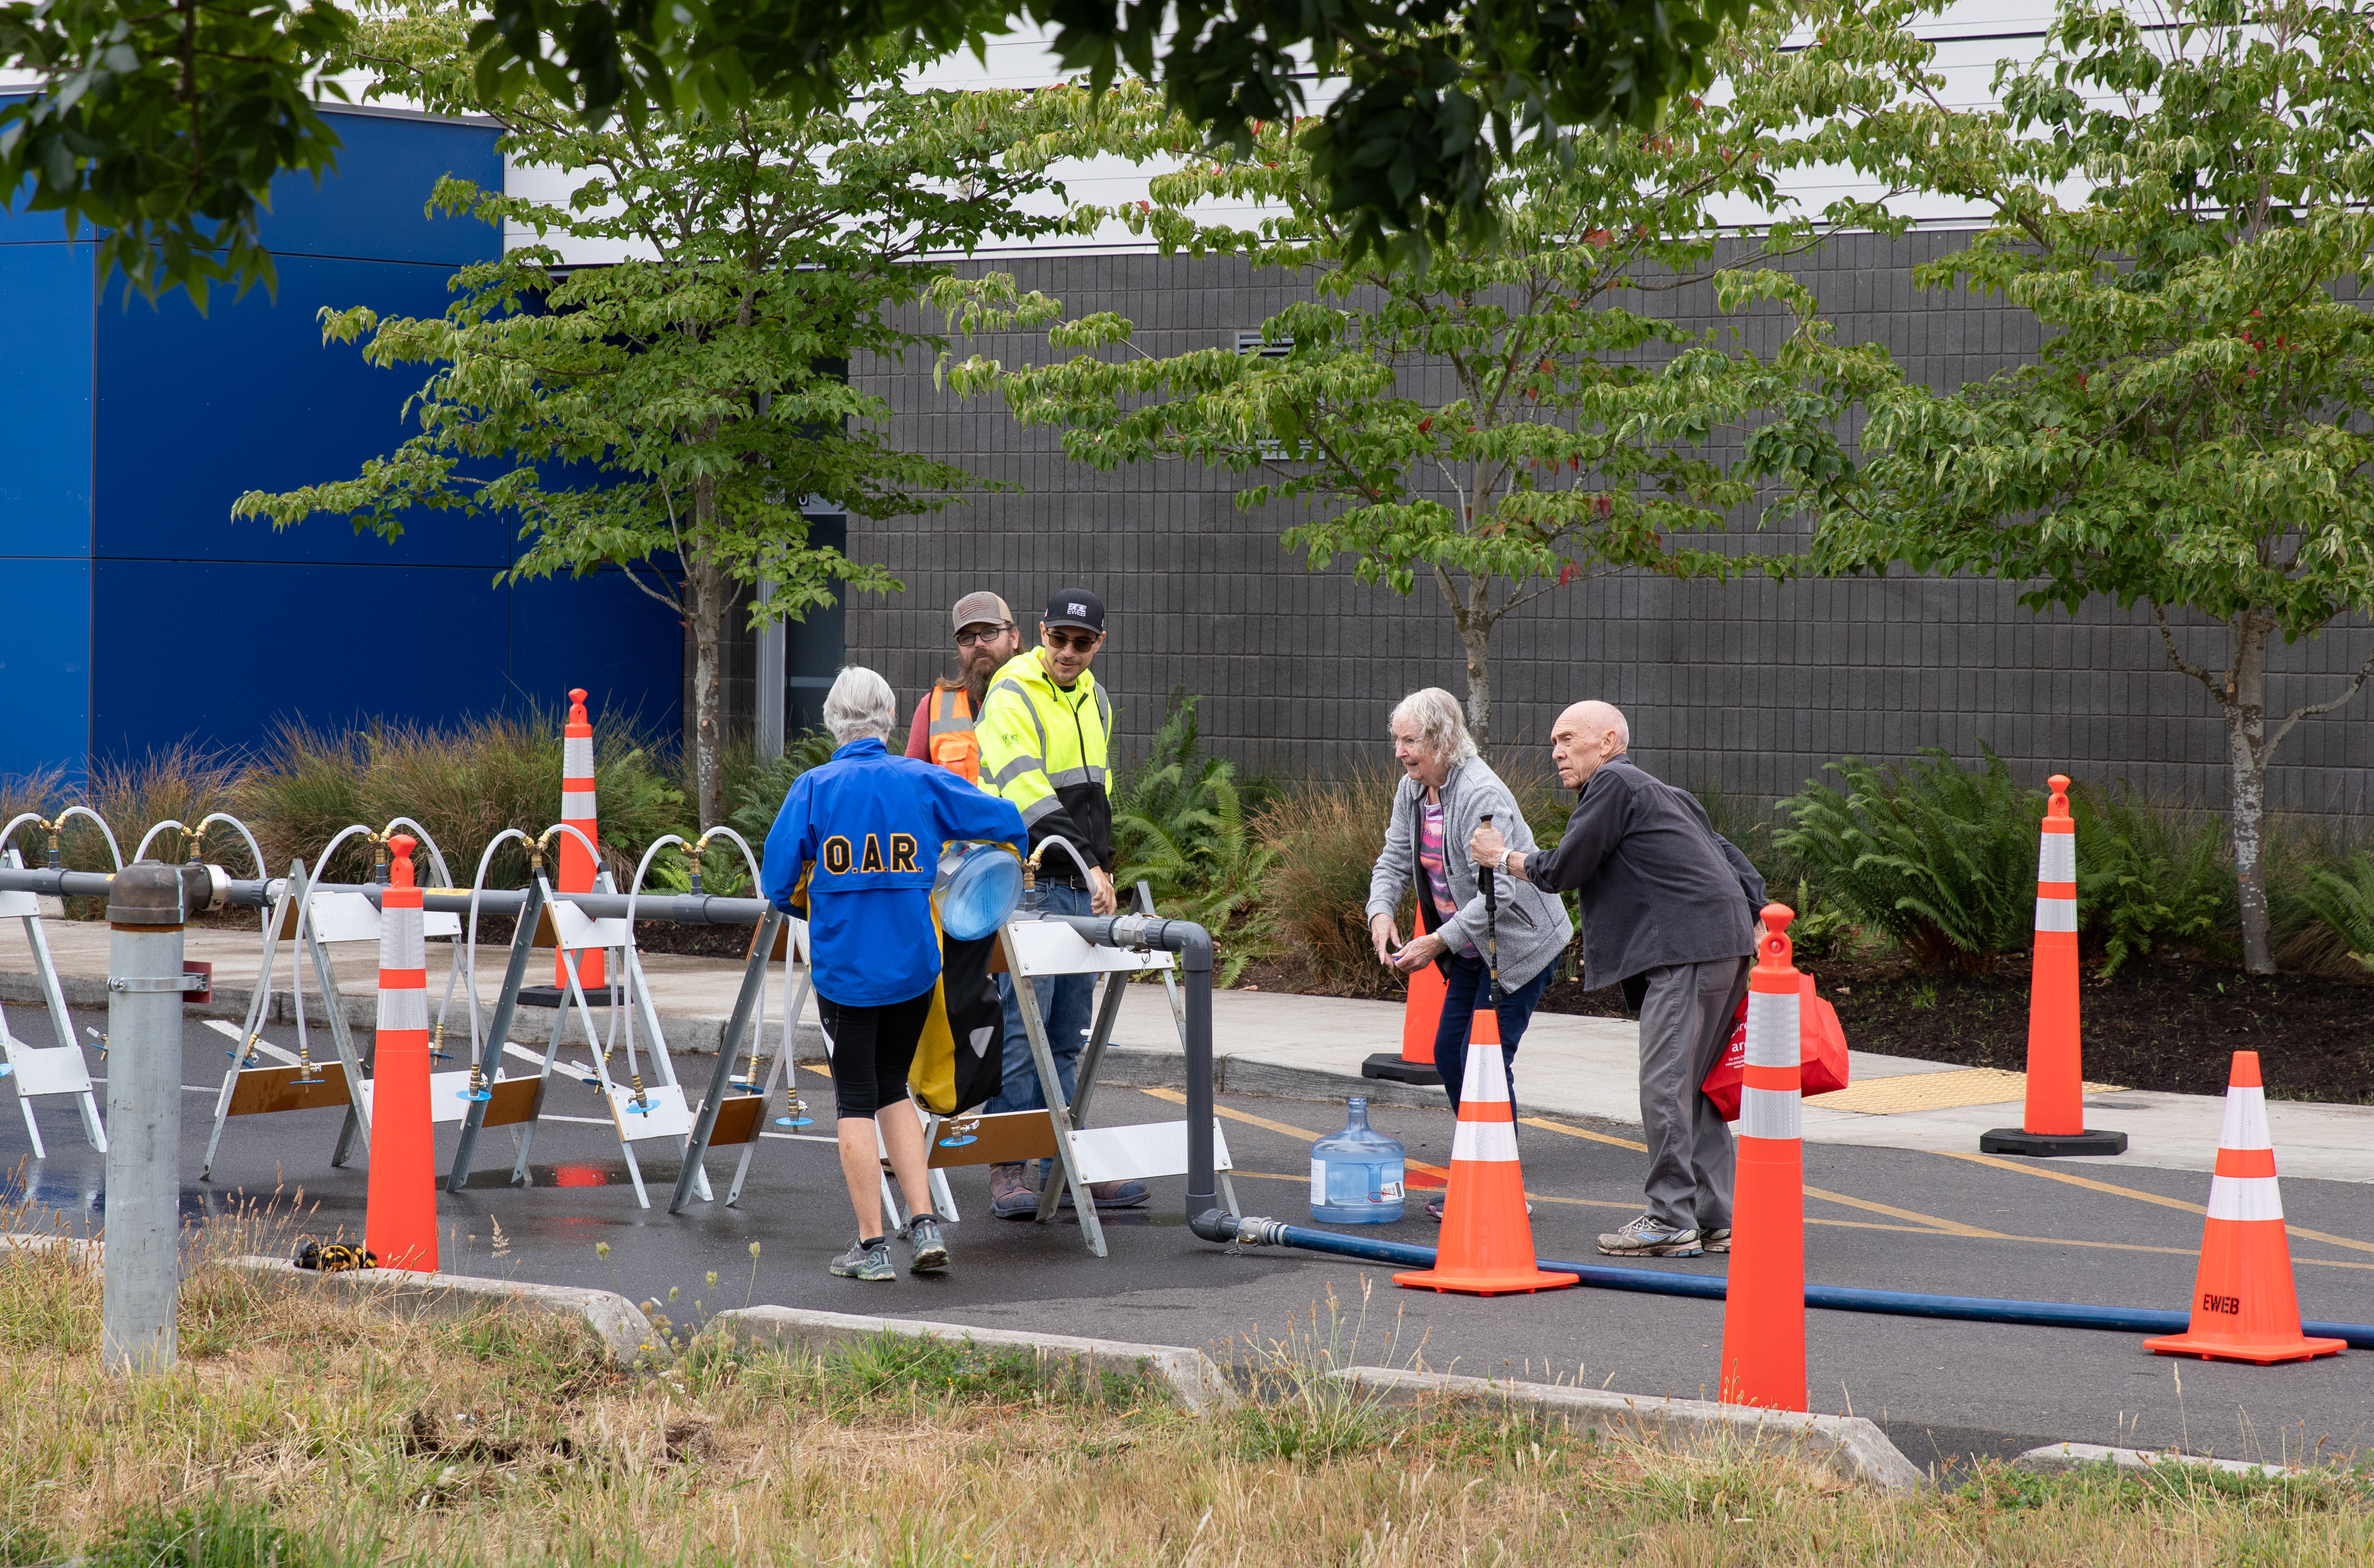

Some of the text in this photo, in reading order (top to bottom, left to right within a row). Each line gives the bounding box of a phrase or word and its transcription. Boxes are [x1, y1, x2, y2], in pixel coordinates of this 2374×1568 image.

[1067, 609, 1086, 617] EWEB
[823, 833, 924, 875] O.A.R.
[1731, 1041, 1745, 1052] ar
[2203, 1293, 2240, 1315] EWEB
